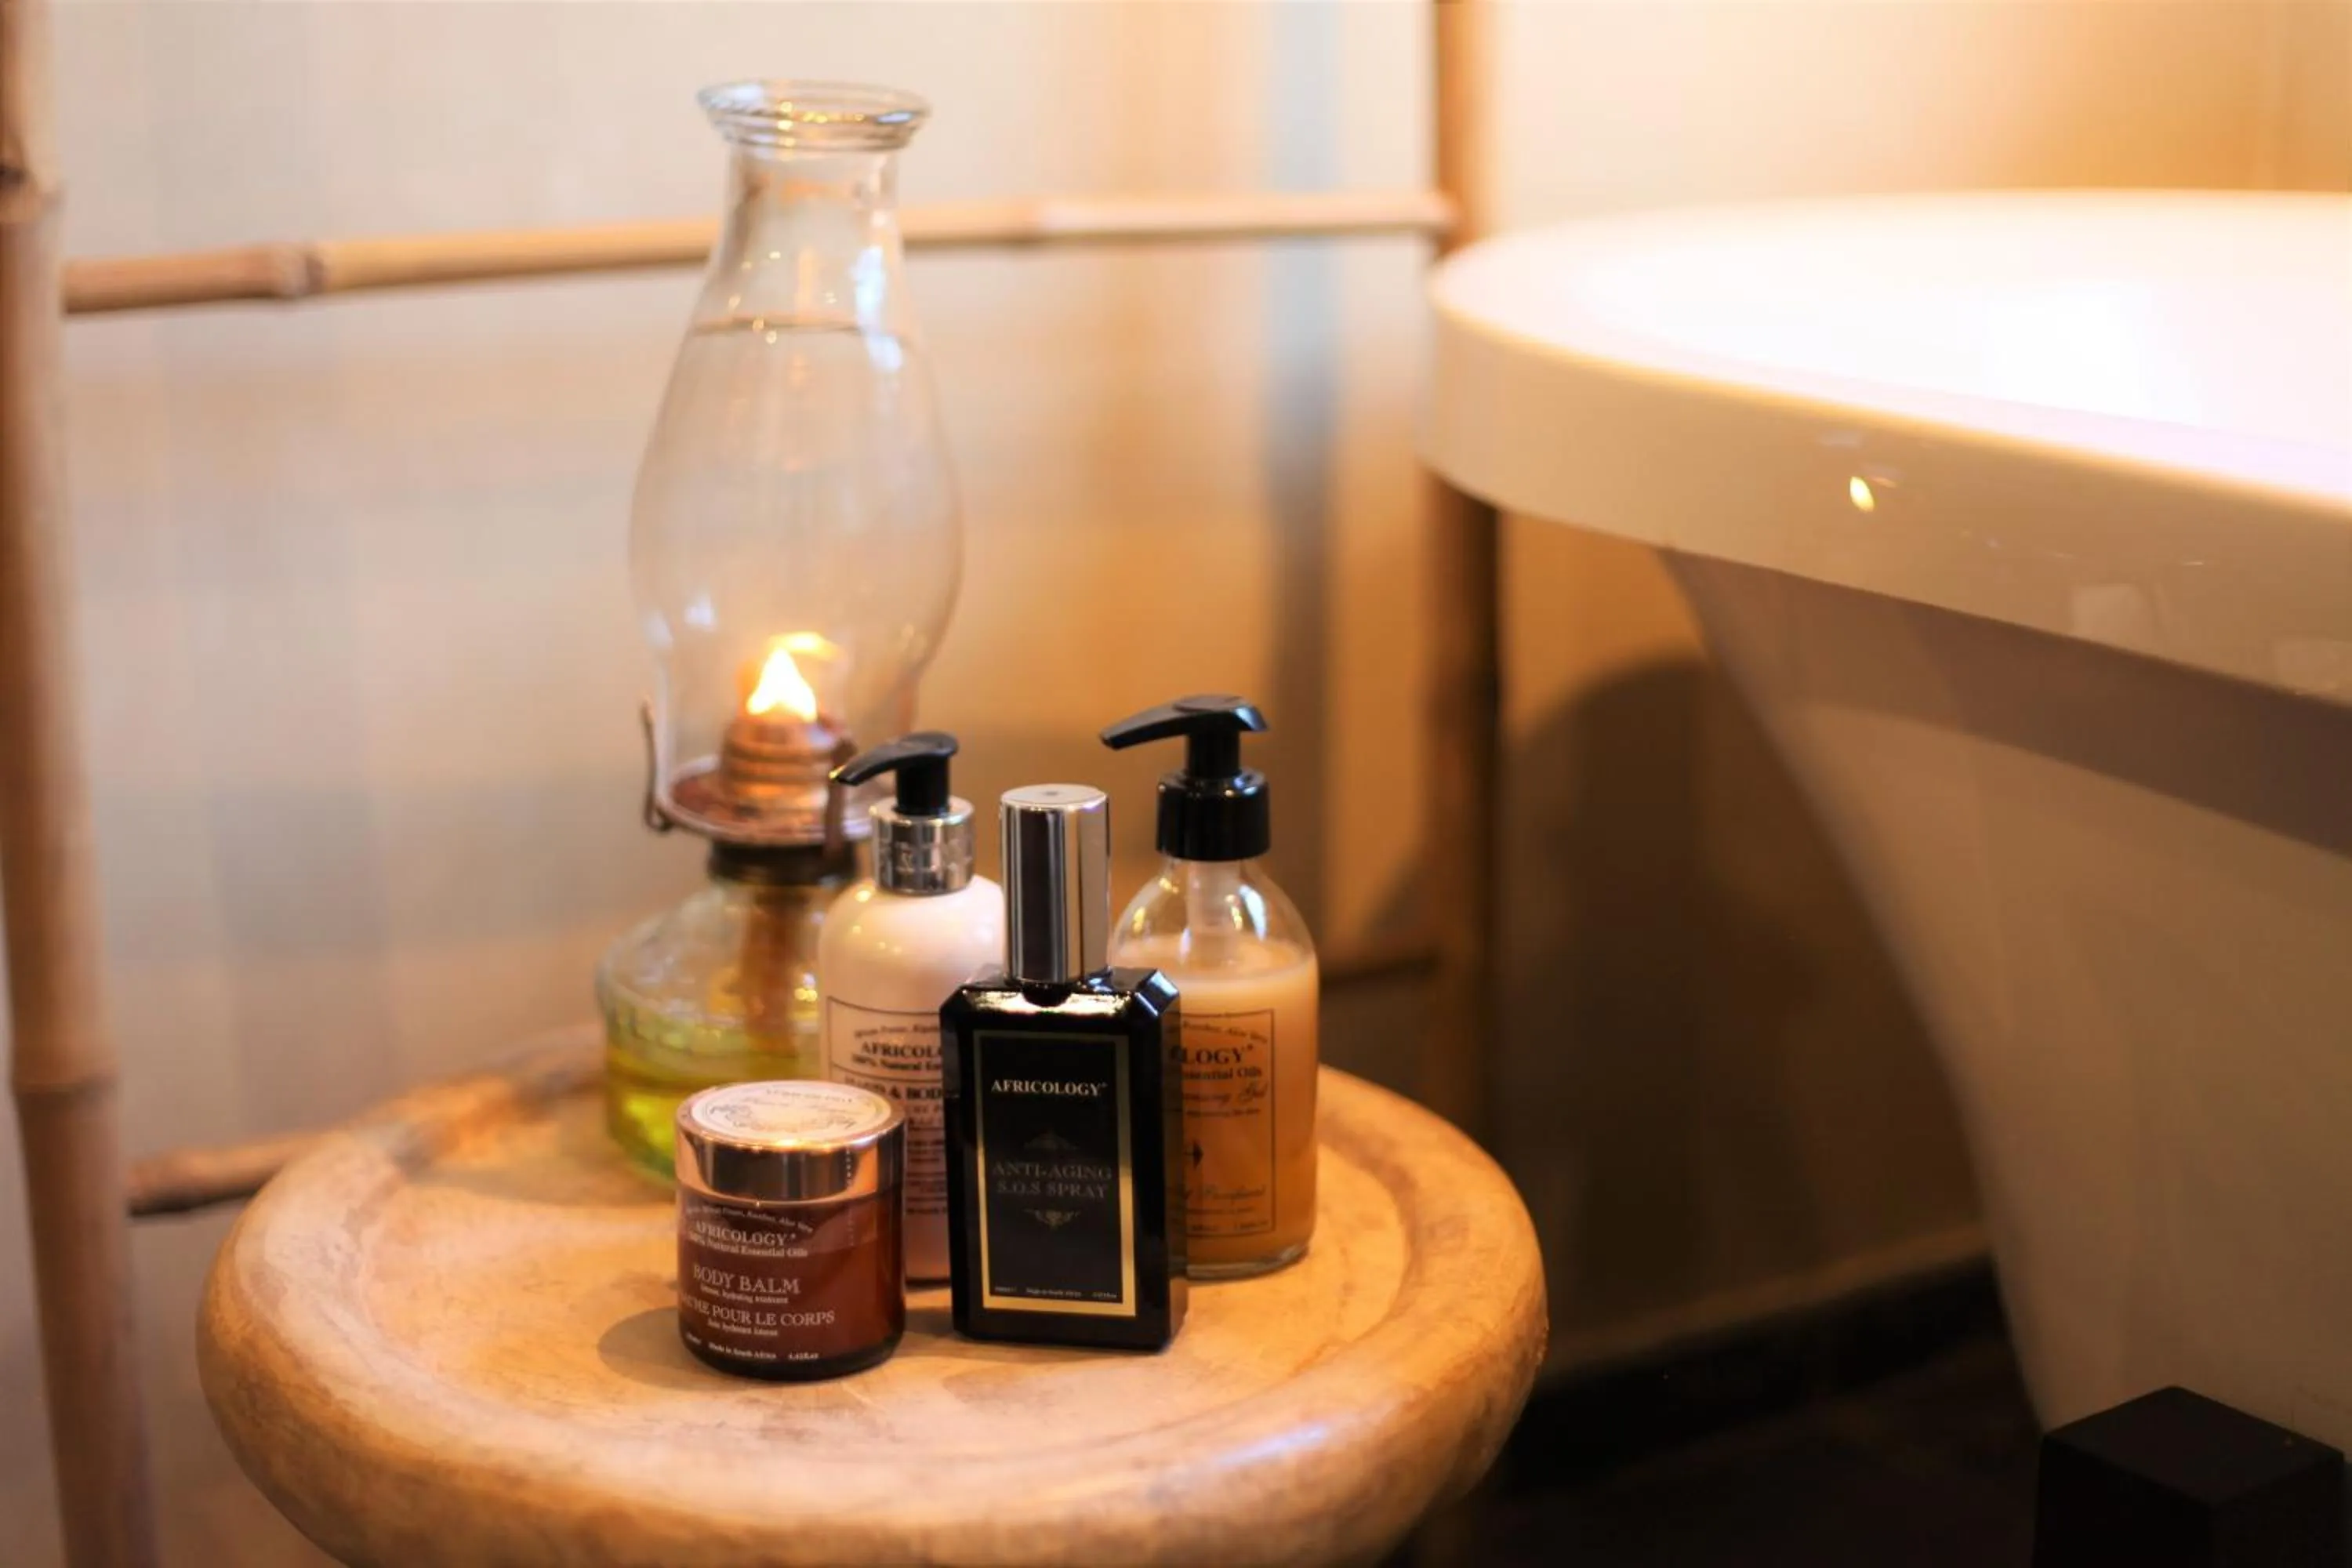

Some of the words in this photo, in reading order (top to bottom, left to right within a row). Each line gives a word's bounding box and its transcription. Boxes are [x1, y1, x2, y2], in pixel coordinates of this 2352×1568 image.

[906, 1087, 943, 1099] BOD
[991, 1160, 1113, 1180] ANTI-AGING
[1045, 1181, 1109, 1199] SPRAY
[692, 1263, 736, 1289] BODY
[739, 1275, 802, 1295] BALM
[712, 1304, 753, 1326] POUR
[755, 1312, 778, 1327] LE
[780, 1309, 836, 1327] CORPS
